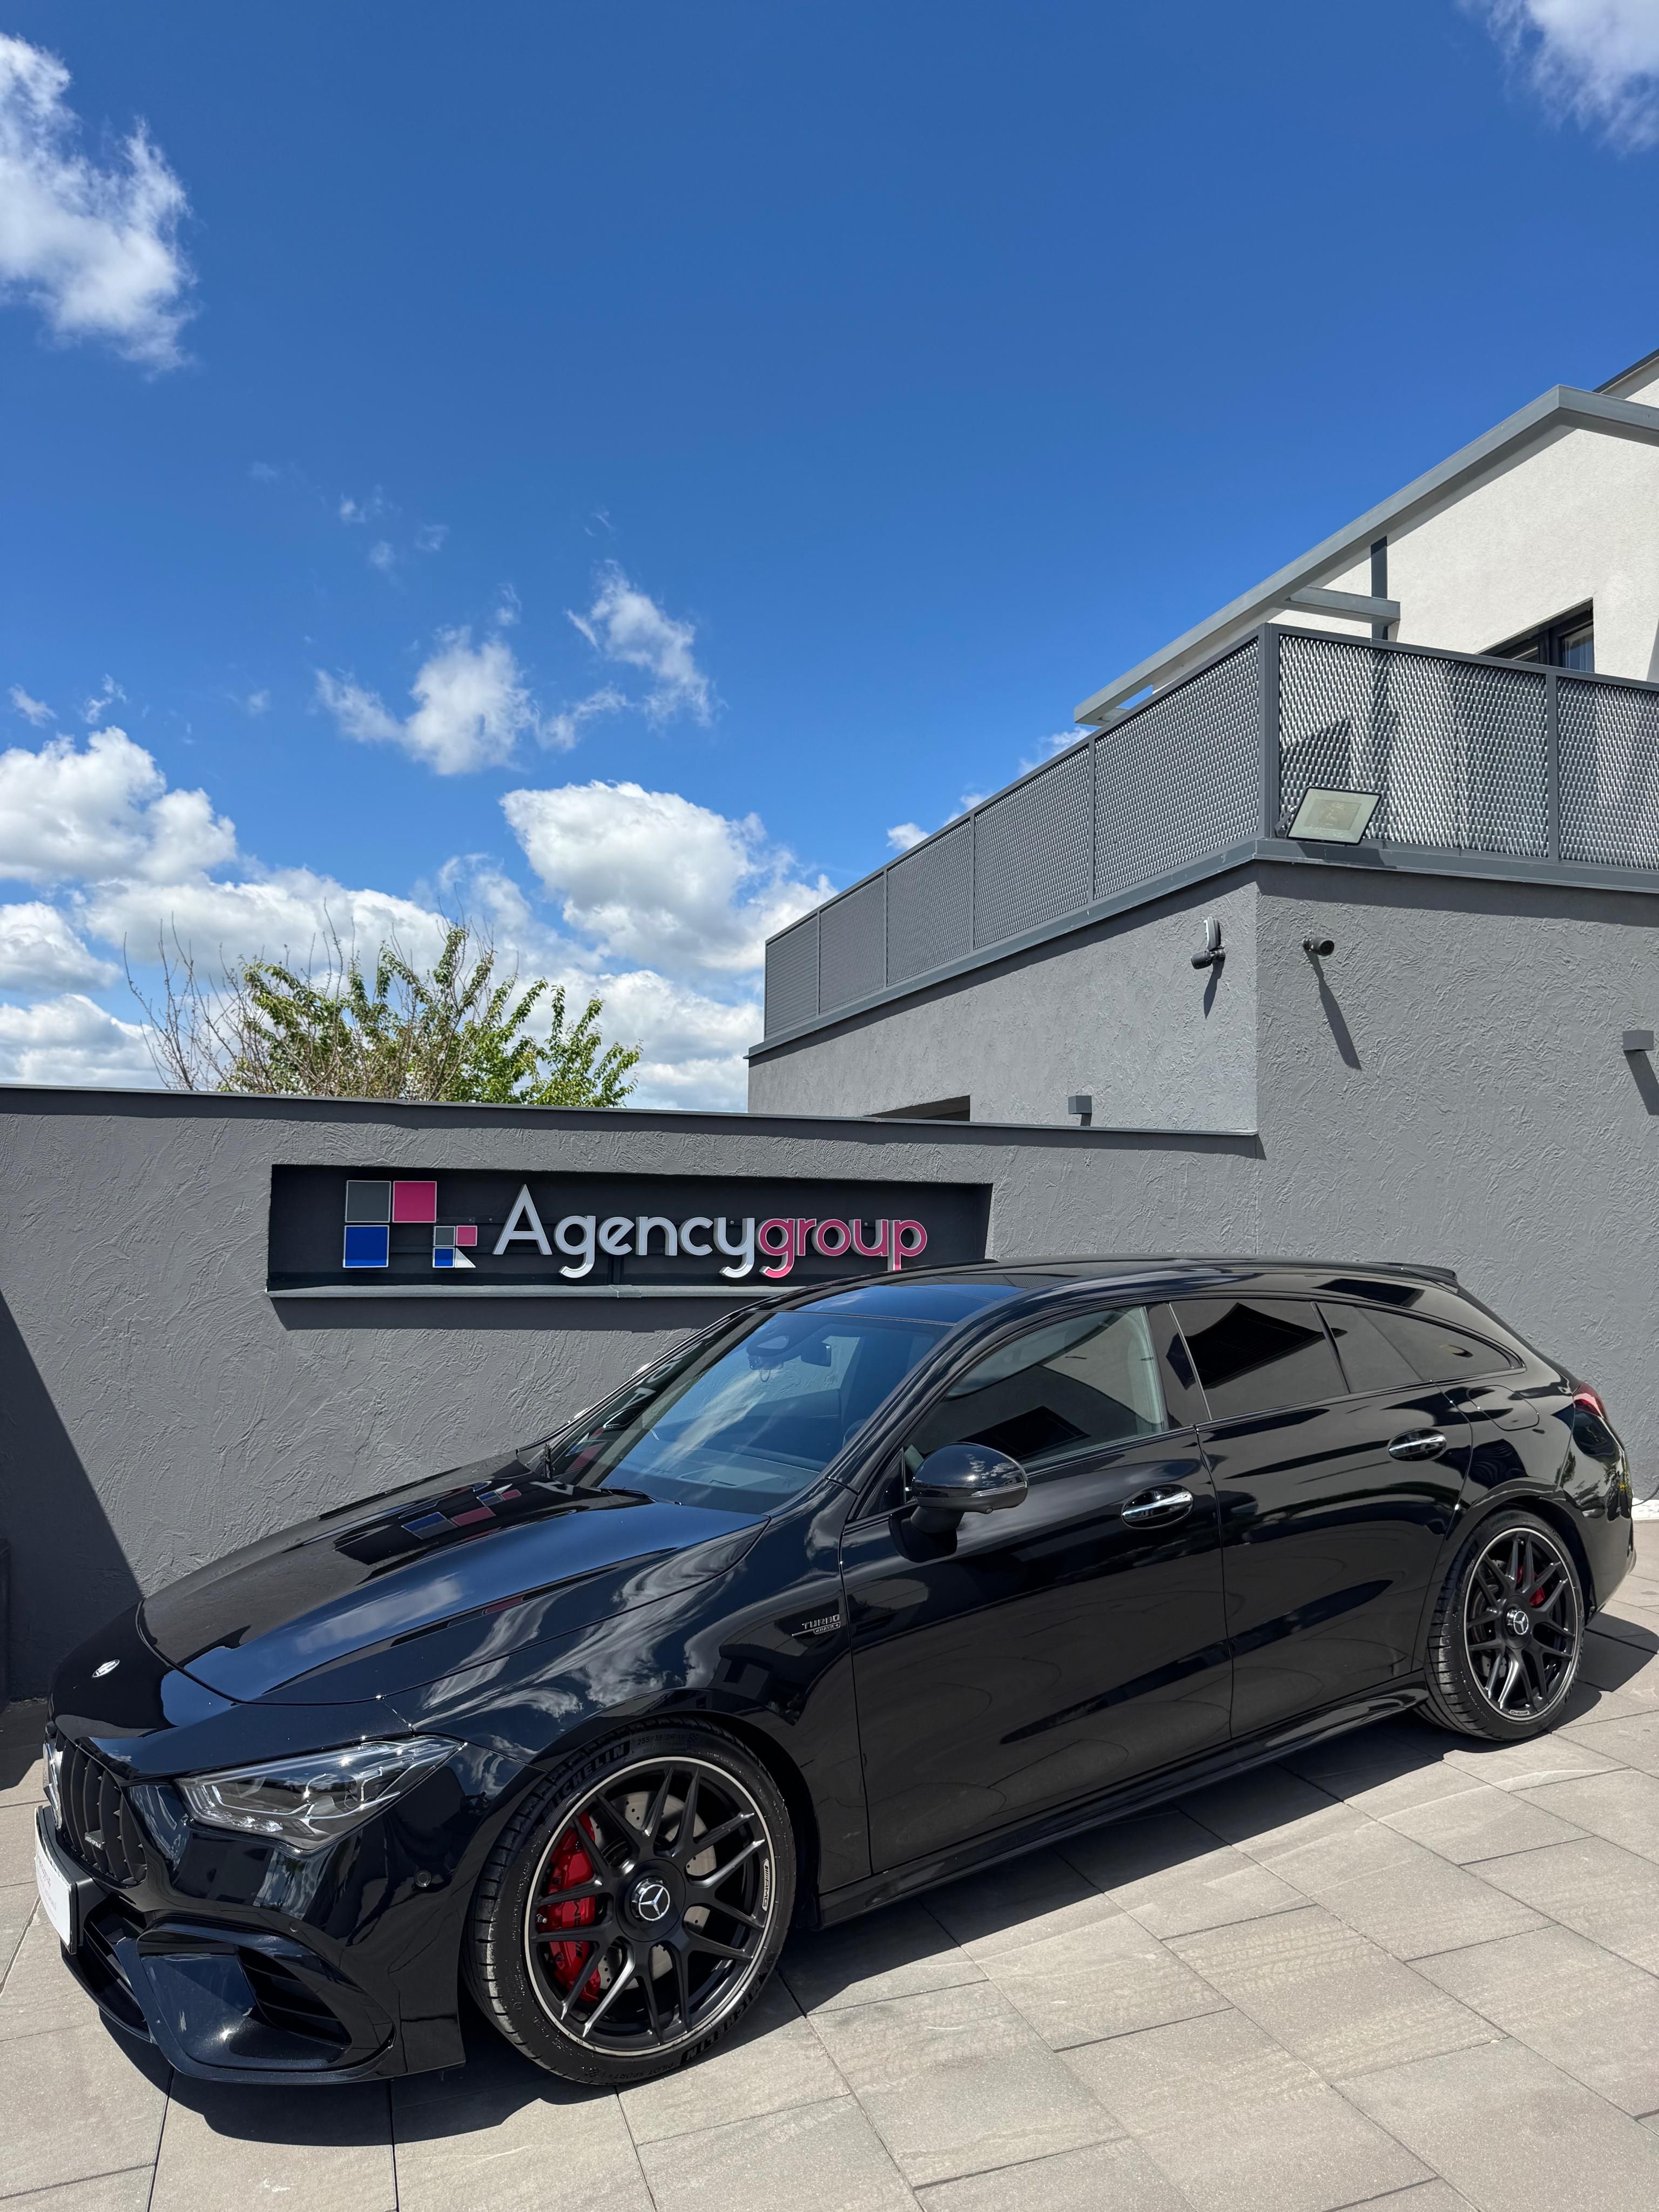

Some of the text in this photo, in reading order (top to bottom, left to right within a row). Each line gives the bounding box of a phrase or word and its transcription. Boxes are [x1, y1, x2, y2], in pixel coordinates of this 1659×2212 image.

[801, 1614, 840, 1629] TURBO
[542, 1744, 624, 1820] MICHELIN
[686, 1978, 761, 2060] MICHELIN
[614, 2071, 645, 2079] SPORT
[648, 2062, 674, 2075] PILOT
